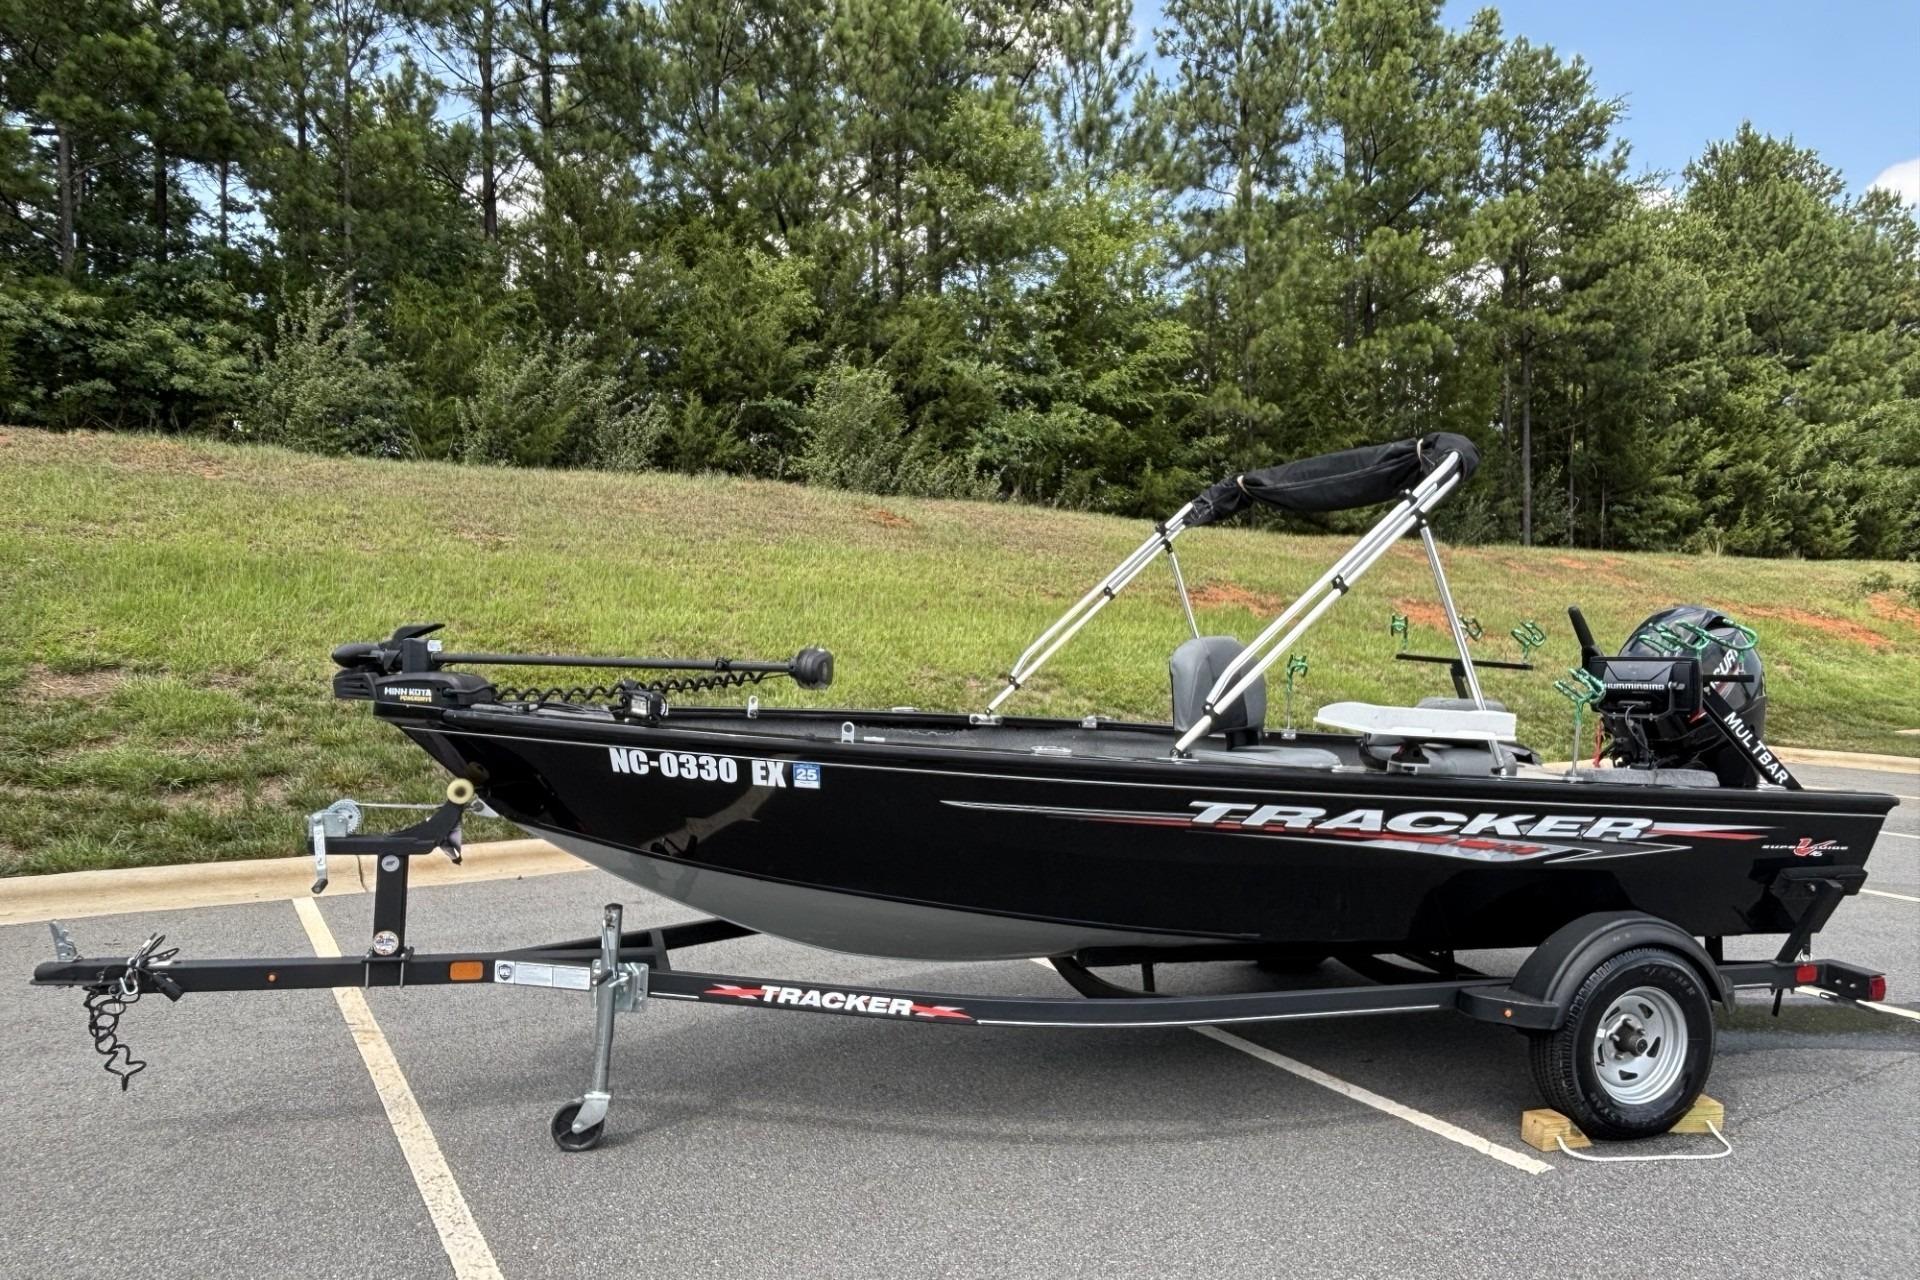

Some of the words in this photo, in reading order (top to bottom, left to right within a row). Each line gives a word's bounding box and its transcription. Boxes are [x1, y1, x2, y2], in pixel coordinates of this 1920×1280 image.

[384, 687, 408, 696] MINN
[409, 688, 432, 697] KOTA
[1723, 711, 1789, 785] MULTBAR
[609, 747, 738, 783] NC-0330
[752, 760, 787, 788] EX
[796, 768, 817, 781] 25
[1190, 801, 1656, 839] TRACKER
[760, 985, 913, 1016] TRACKER
